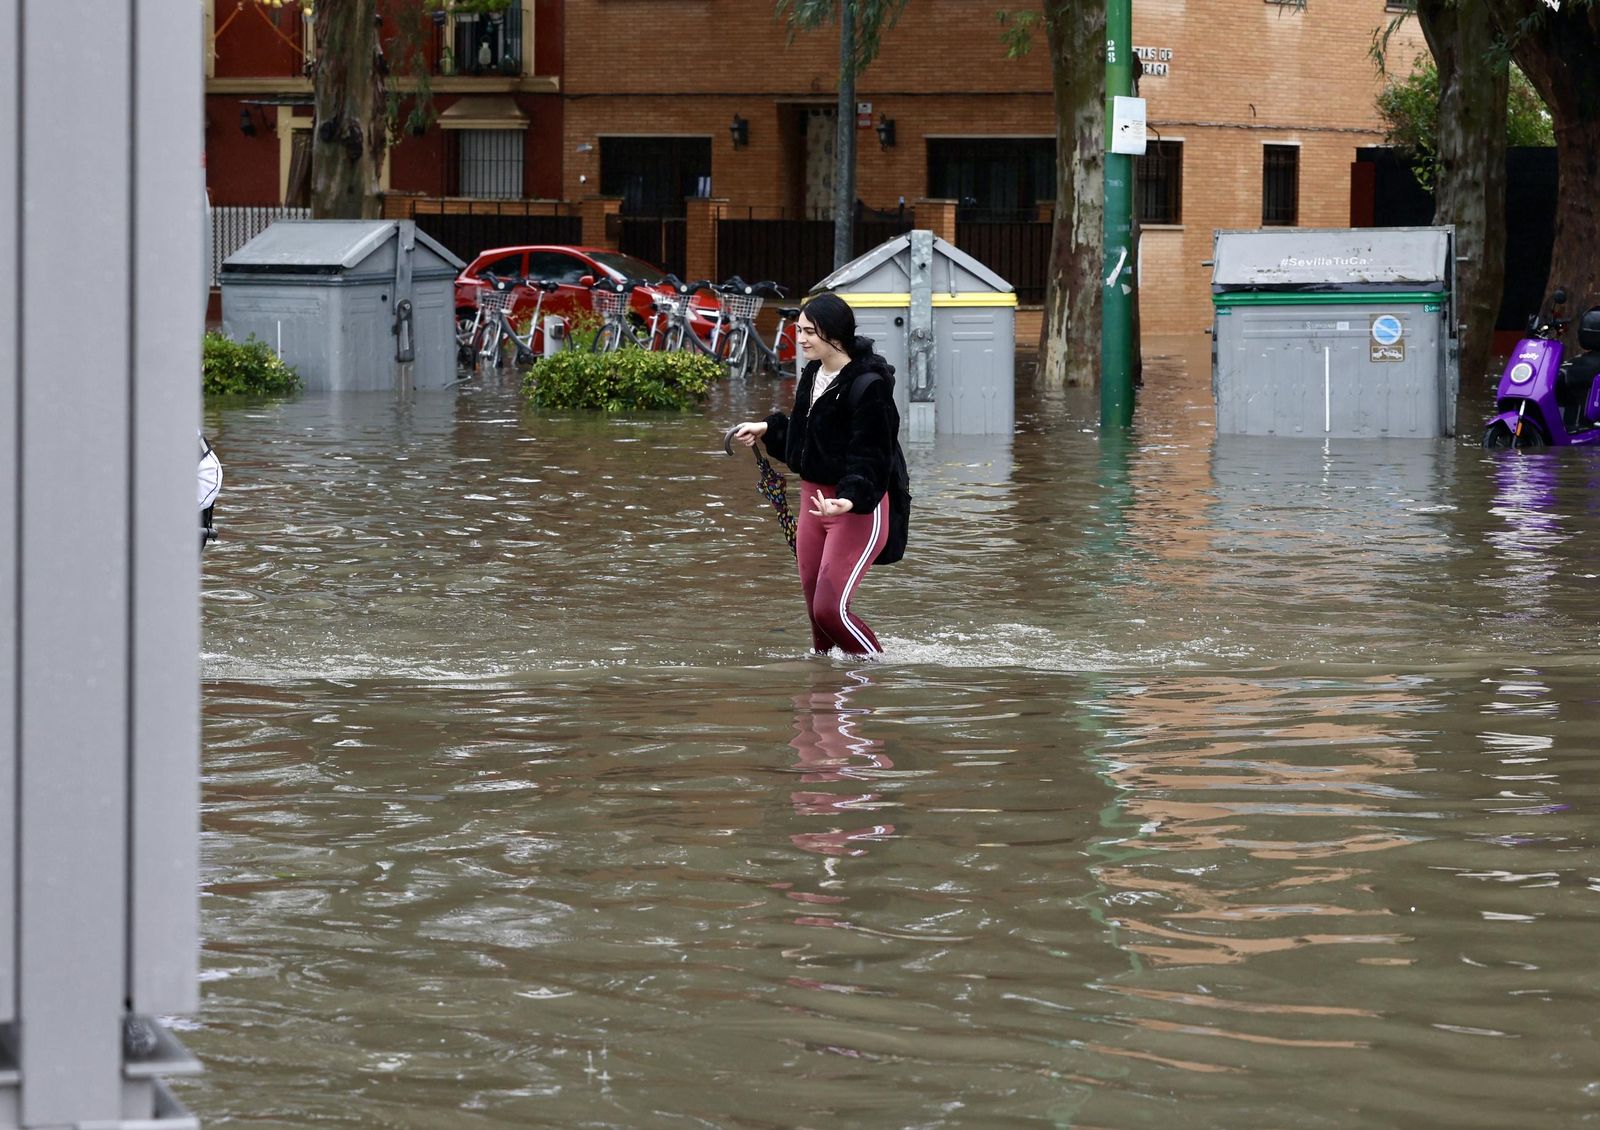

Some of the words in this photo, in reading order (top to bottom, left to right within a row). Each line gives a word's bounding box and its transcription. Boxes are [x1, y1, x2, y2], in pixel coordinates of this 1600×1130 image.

[1160, 49, 1172, 60] DE
[1144, 63, 1167, 75] EAGA
[1280, 256, 1373, 267] #SevillaTuCa
